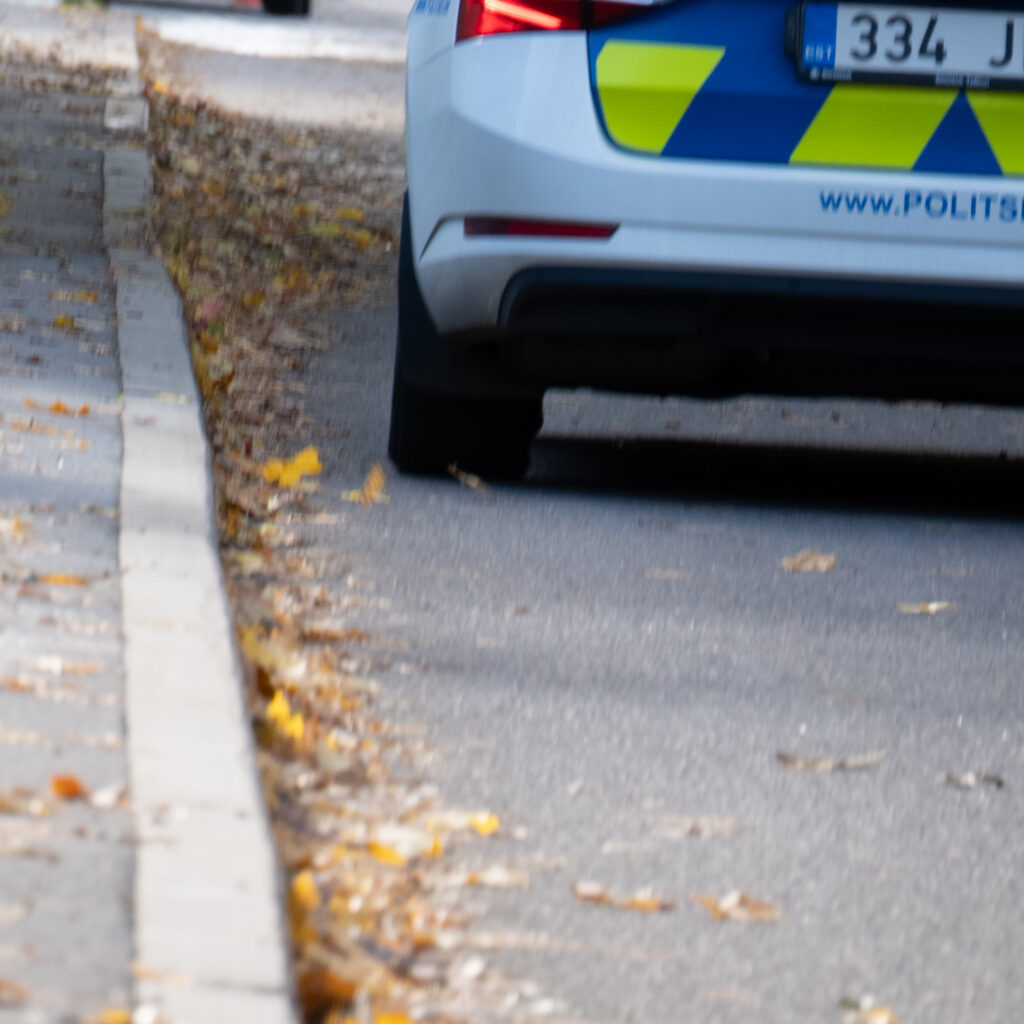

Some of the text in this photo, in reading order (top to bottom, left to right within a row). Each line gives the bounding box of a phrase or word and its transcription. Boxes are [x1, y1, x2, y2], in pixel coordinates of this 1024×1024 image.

[850, 11, 1024, 68] 334 J
[819, 188, 1024, 223] www.POLITS
